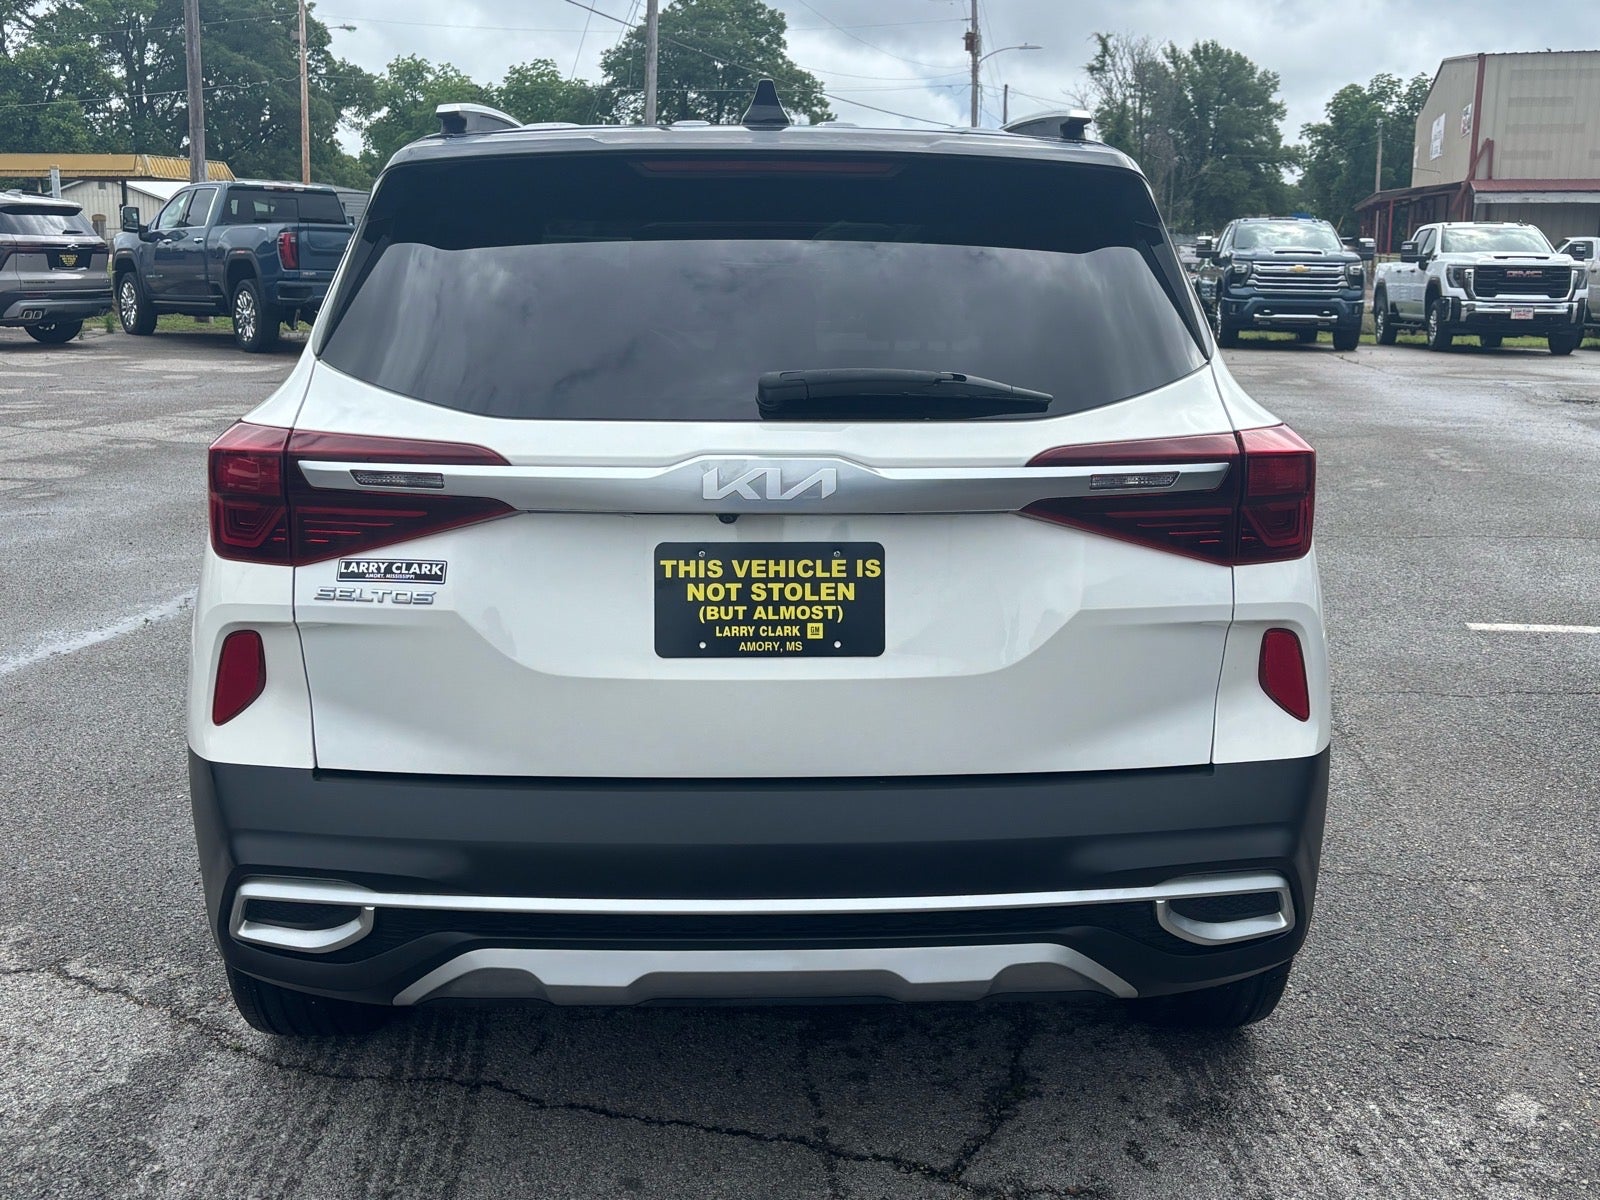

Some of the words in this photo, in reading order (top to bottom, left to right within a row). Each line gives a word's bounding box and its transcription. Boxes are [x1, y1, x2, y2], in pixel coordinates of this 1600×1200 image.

[702, 467, 837, 500] KIA
[340, 562, 388, 573] LARRY
[392, 562, 443, 575] CLARK
[660, 559, 724, 578] THIS
[732, 559, 847, 578] VEHICLE
[856, 559, 882, 578] IS
[314, 586, 437, 605] SELTOS
[687, 582, 742, 601] NOT
[751, 582, 855, 601] STOLEN
[698, 605, 747, 623] (BUT
[753, 605, 844, 623] ALMOST)
[715, 626, 754, 637] LARRY
[759, 626, 801, 637] CLARK
[810, 626, 820, 635] GM
[739, 641, 783, 652] AMORY,
[786, 641, 803, 651] MS
